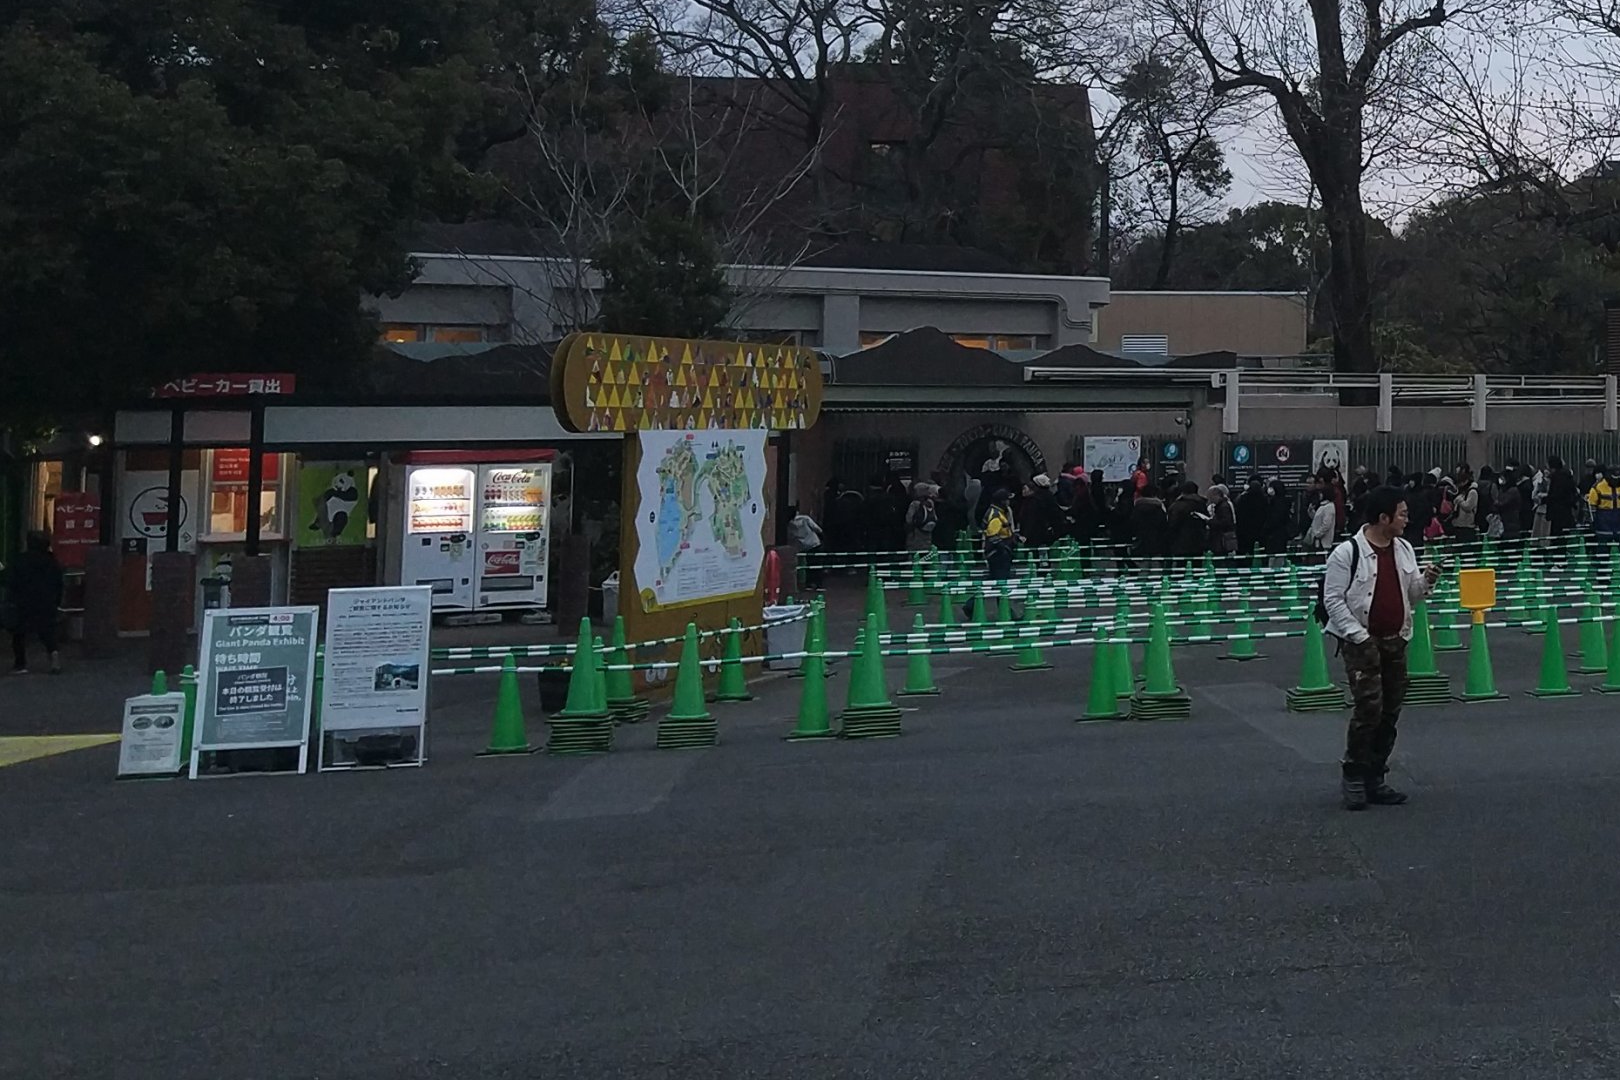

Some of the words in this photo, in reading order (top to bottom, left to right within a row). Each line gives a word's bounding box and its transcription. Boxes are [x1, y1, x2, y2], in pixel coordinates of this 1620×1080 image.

[163, 378, 281, 394] ベビーカー貸出
[215, 639, 241, 648] Giant
[242, 638, 272, 647] Panda
[273, 636, 305, 646] Exhibit
[215, 652, 261, 665] 待ち時間
